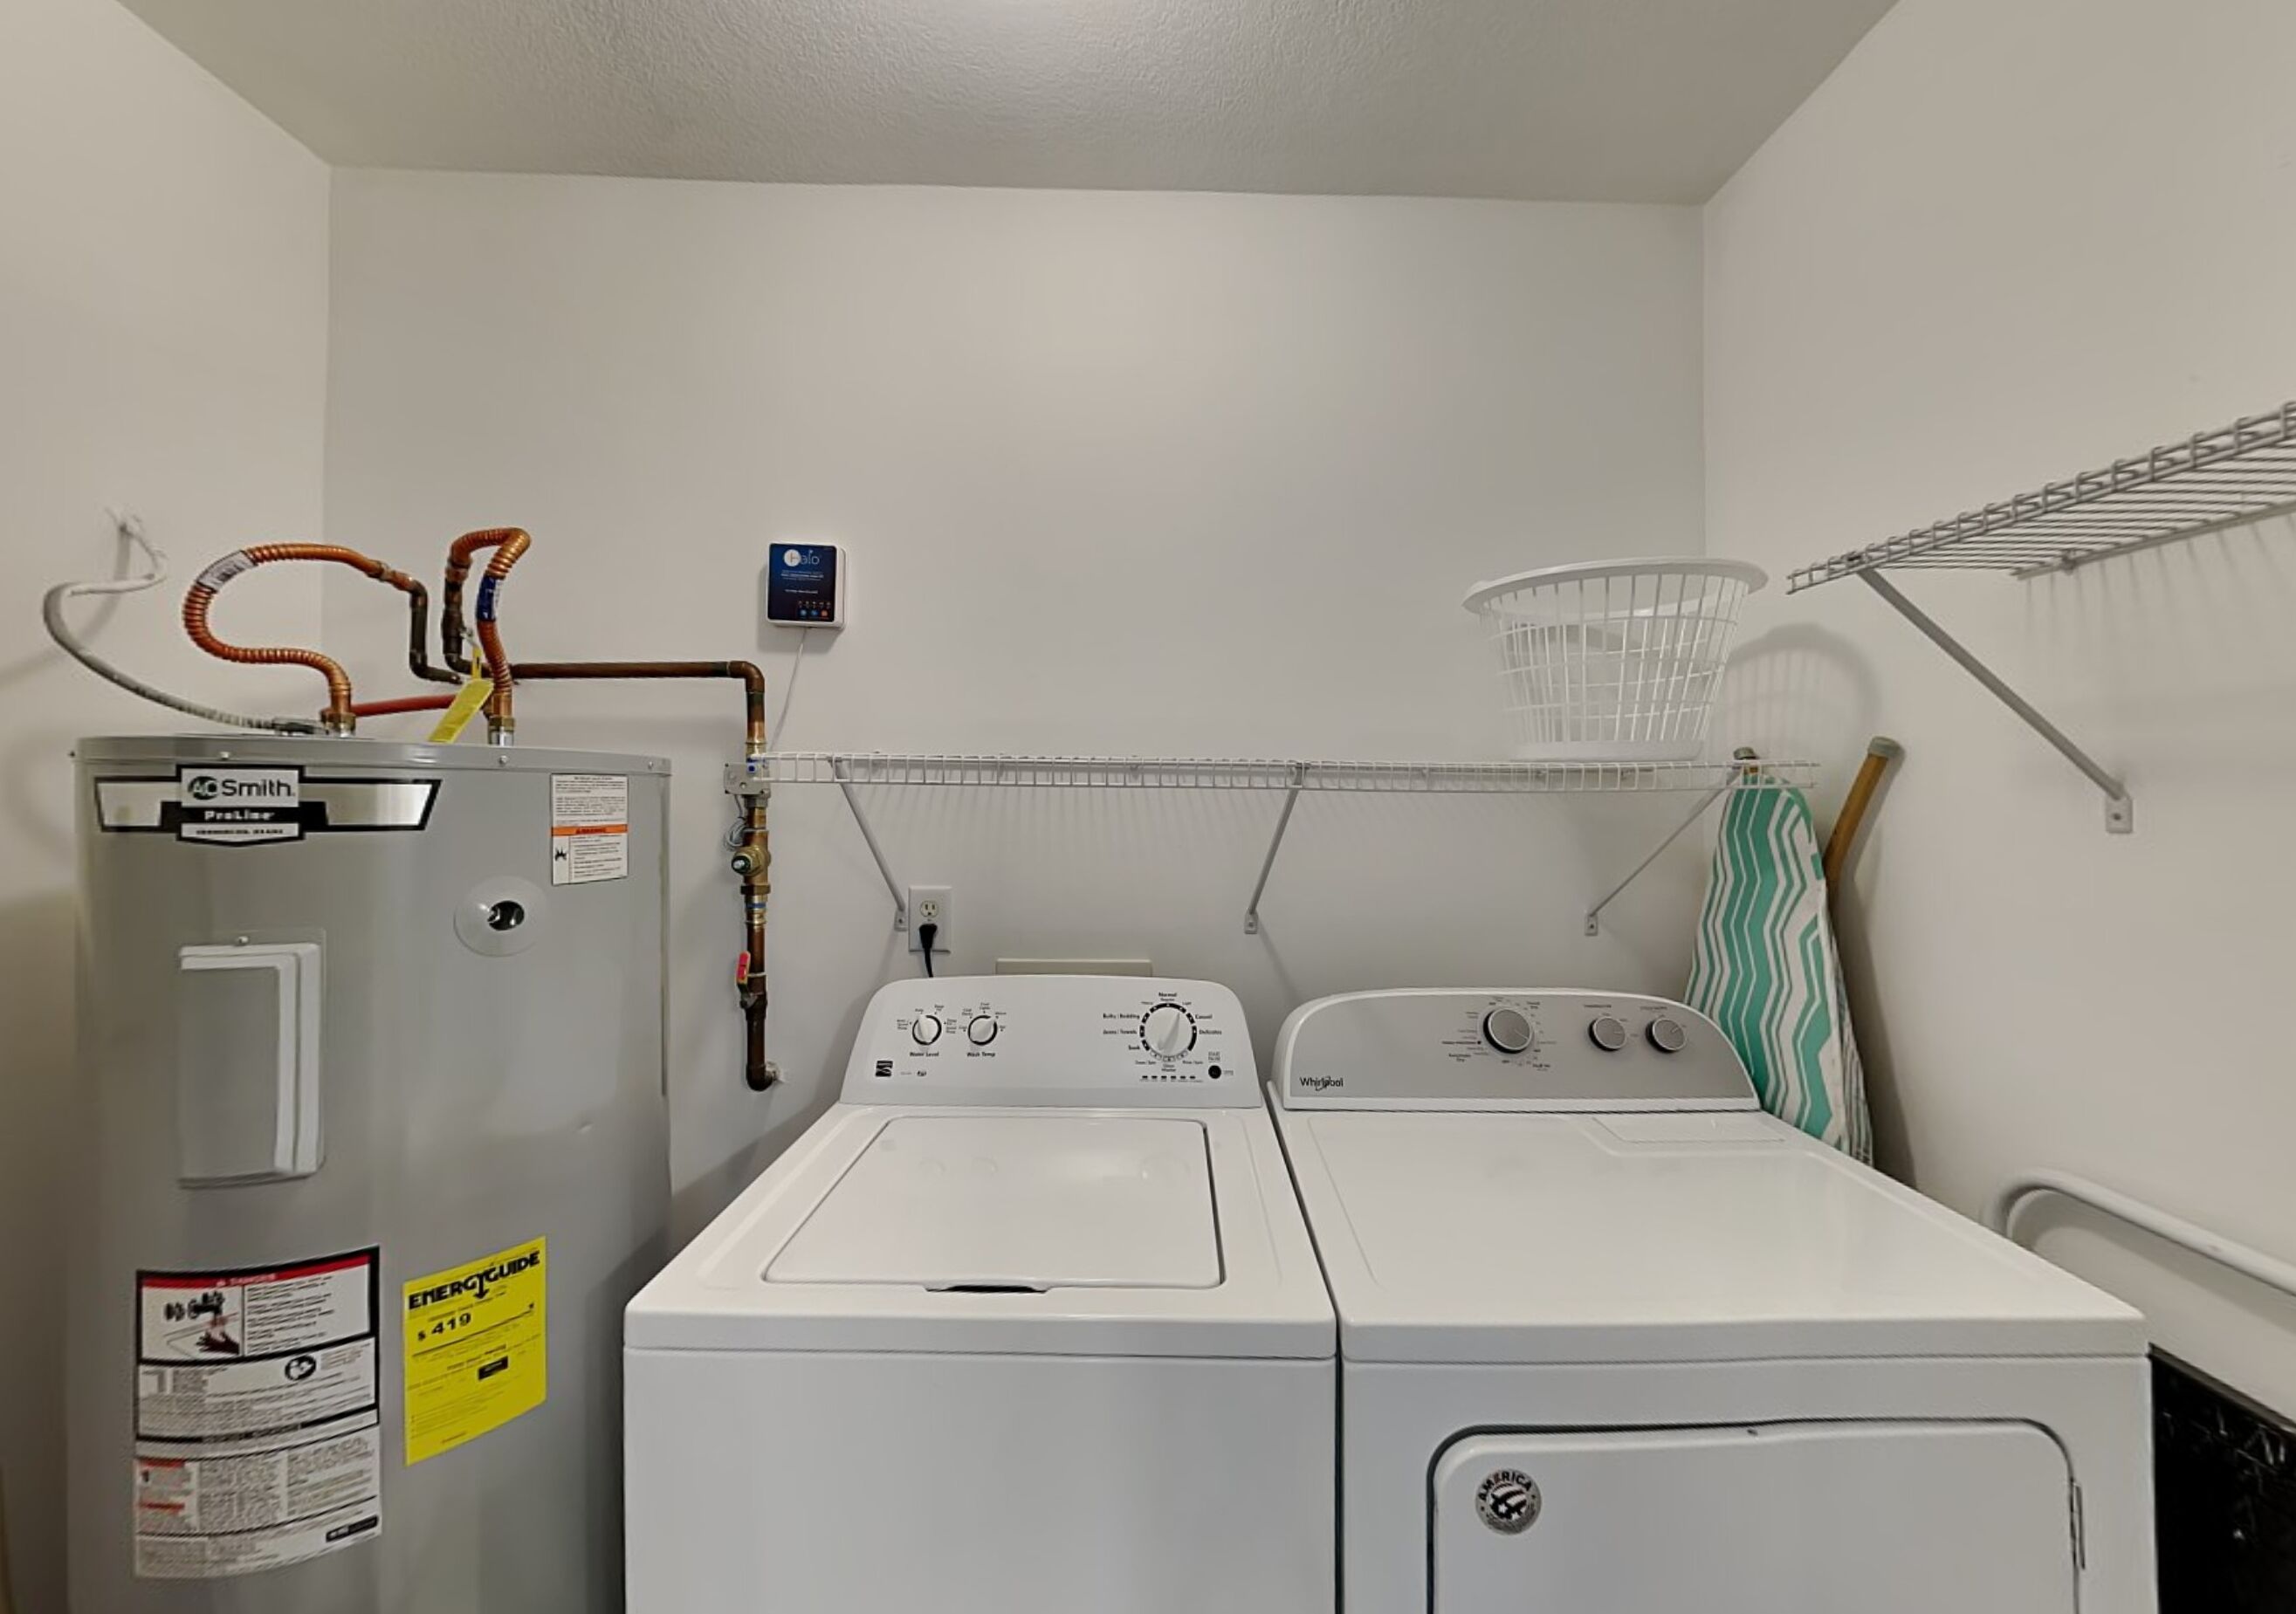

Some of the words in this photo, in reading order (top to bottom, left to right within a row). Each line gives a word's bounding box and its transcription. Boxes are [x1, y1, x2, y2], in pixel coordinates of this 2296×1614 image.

[222, 780, 292, 796] Smith
[1299, 1075, 1344, 1091] Whirlpool
[1477, 1470, 1532, 1501] AMERICA
